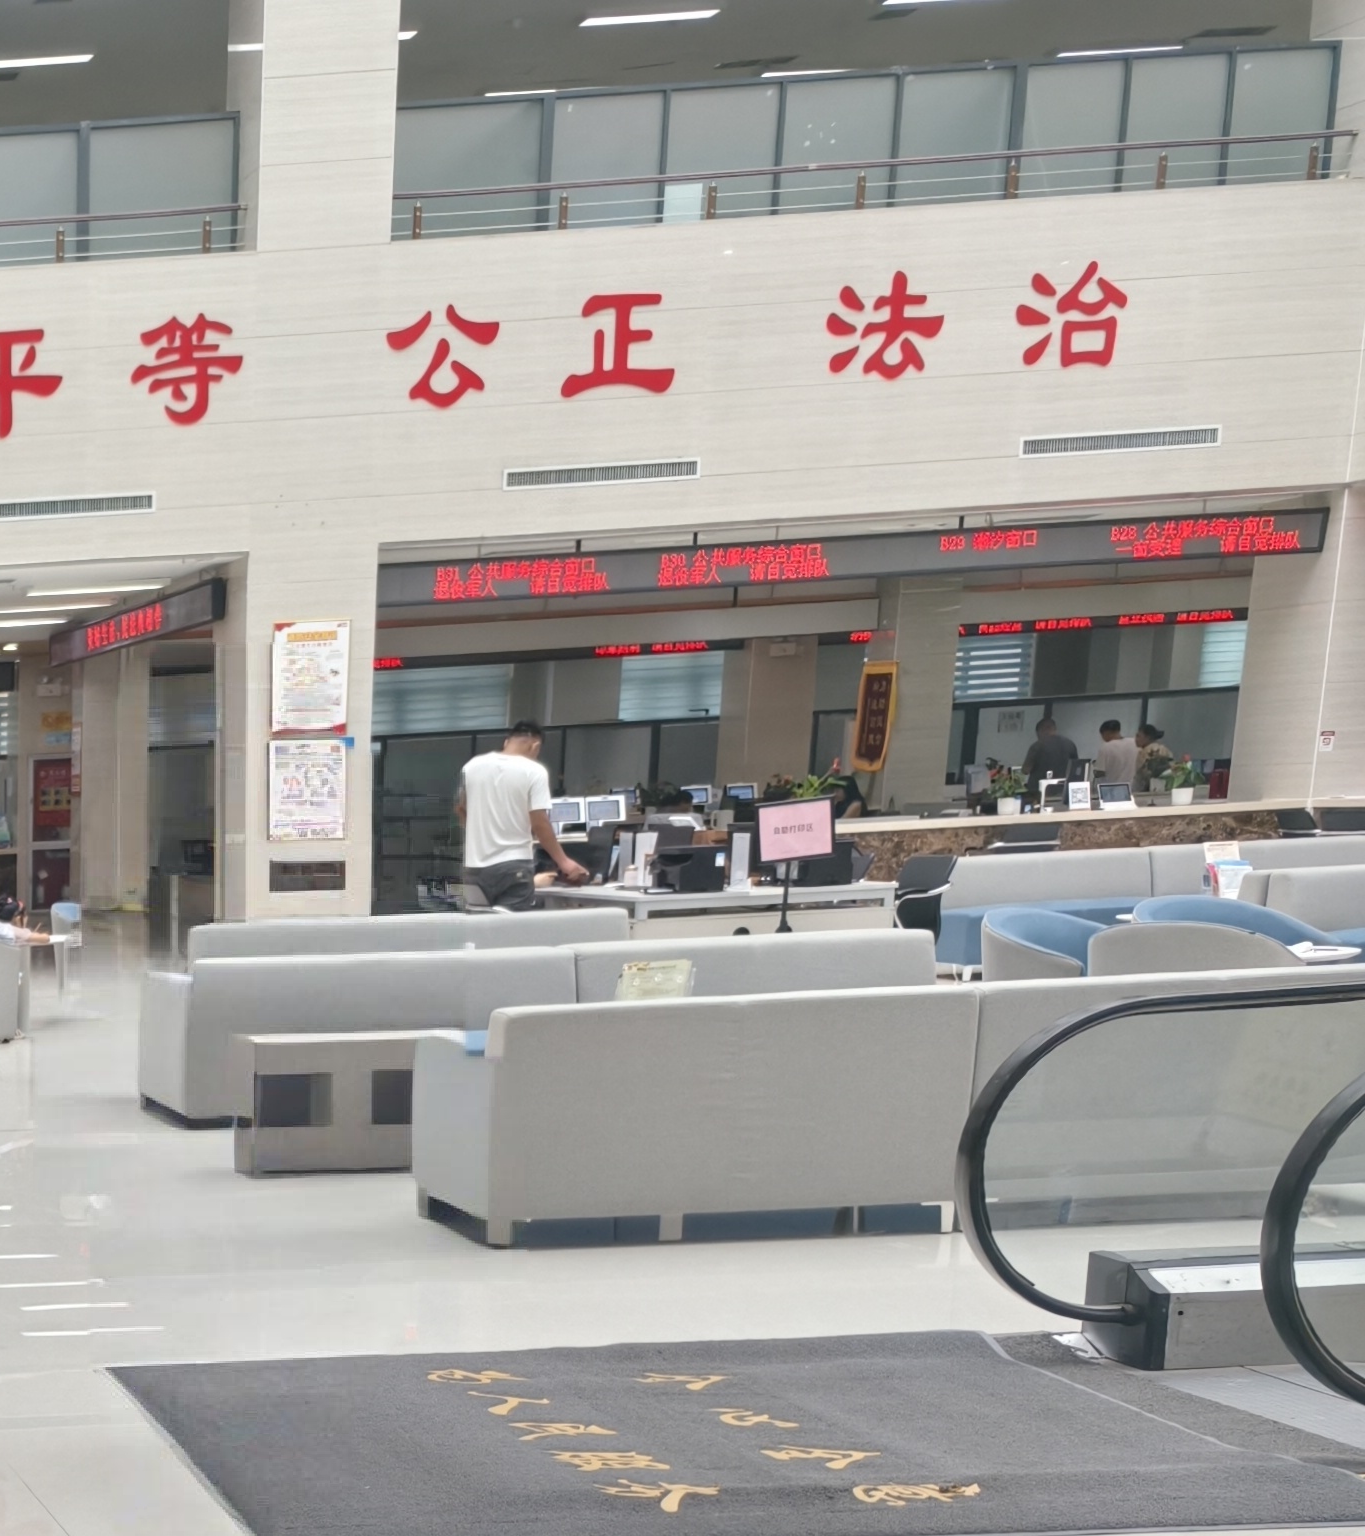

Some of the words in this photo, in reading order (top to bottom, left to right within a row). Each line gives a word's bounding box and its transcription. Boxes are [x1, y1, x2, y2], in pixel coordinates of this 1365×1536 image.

[386, 292, 677, 411] 公正
[826, 262, 1131, 382] 法治
[1144, 516, 1275, 538] 公共服务综合窗口
[1220, 529, 1301, 554] 请自觉排队
[693, 543, 822, 567] 公共服务综合窗口
[468, 557, 596, 580] 公共服务综合窗口
[657, 564, 721, 586] 退役军人
[749, 558, 830, 581] 请自觉排队
[434, 578, 498, 600] 退役军人
[529, 571, 610, 595] 请自觉排队
